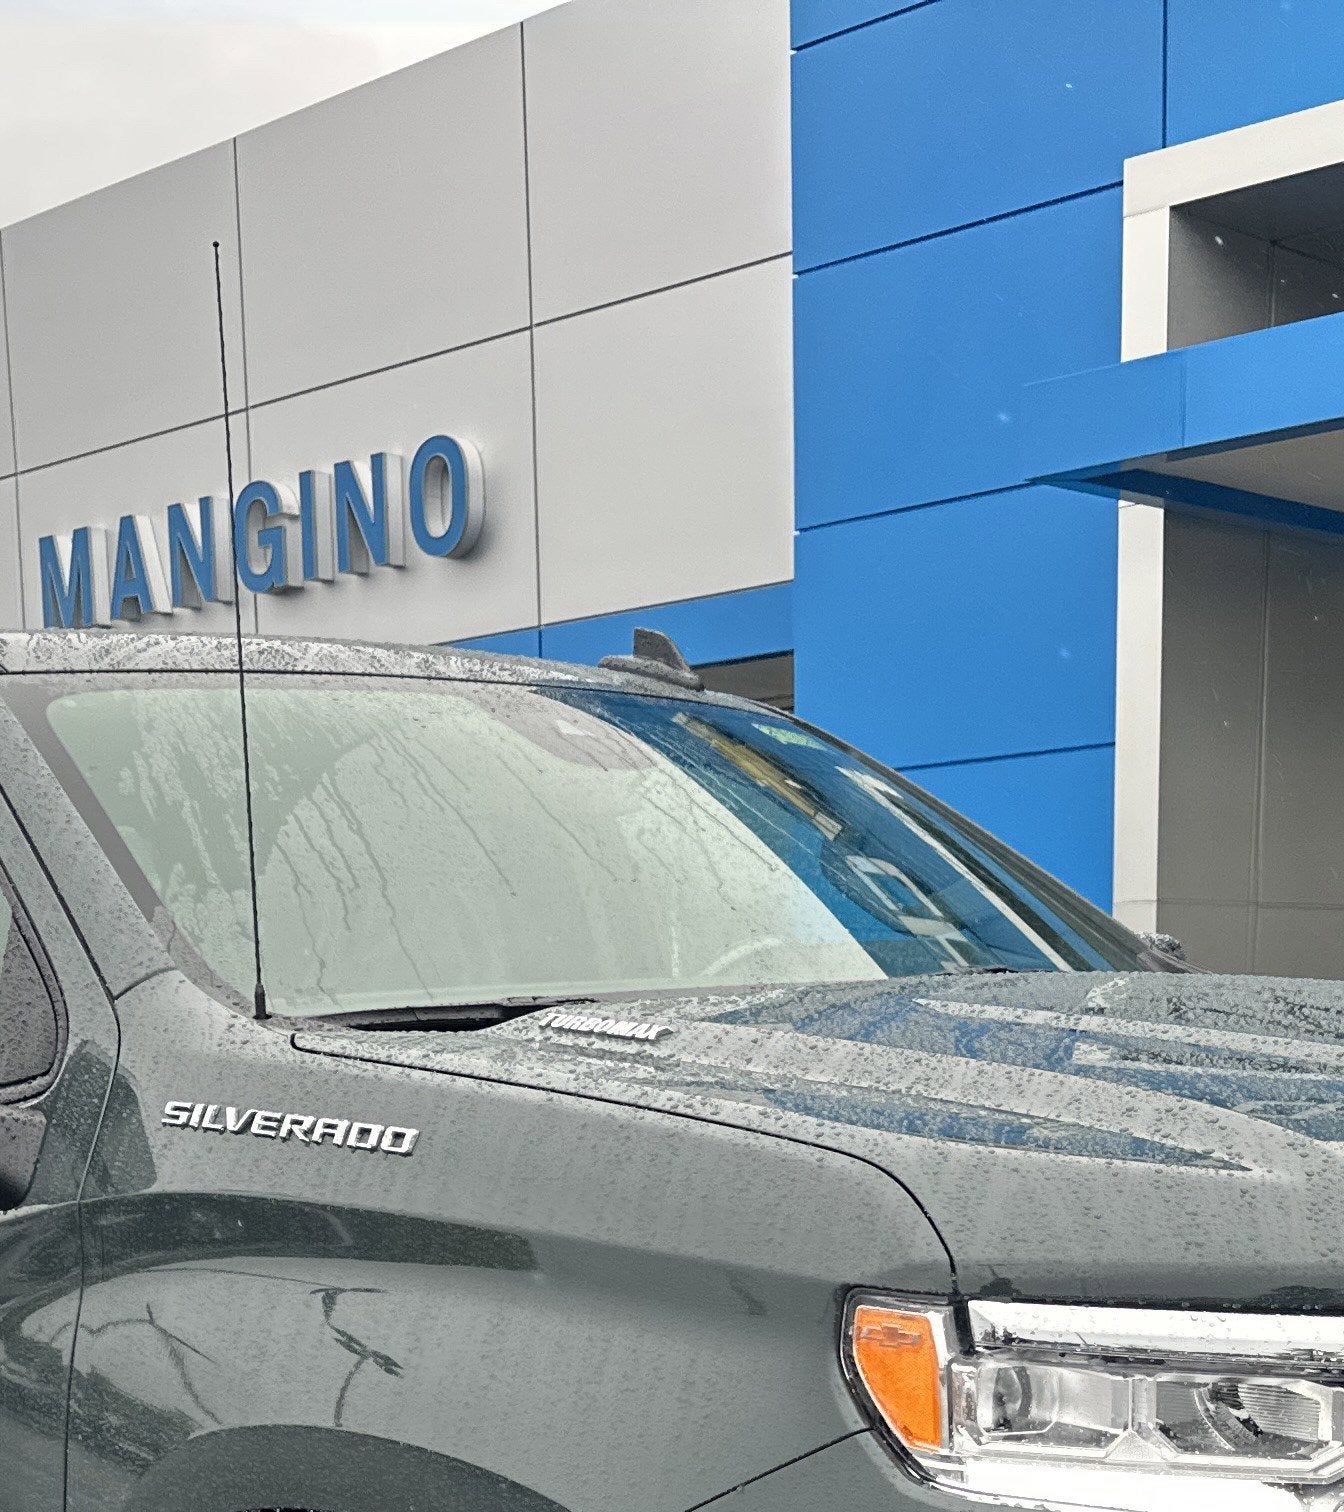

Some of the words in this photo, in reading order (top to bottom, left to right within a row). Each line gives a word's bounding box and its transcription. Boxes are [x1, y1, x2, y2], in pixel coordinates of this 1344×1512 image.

[39, 434, 485, 629] MANGINO
[539, 1012, 669, 1041] TURBOMAX
[161, 1101, 420, 1154] SILVERADO
